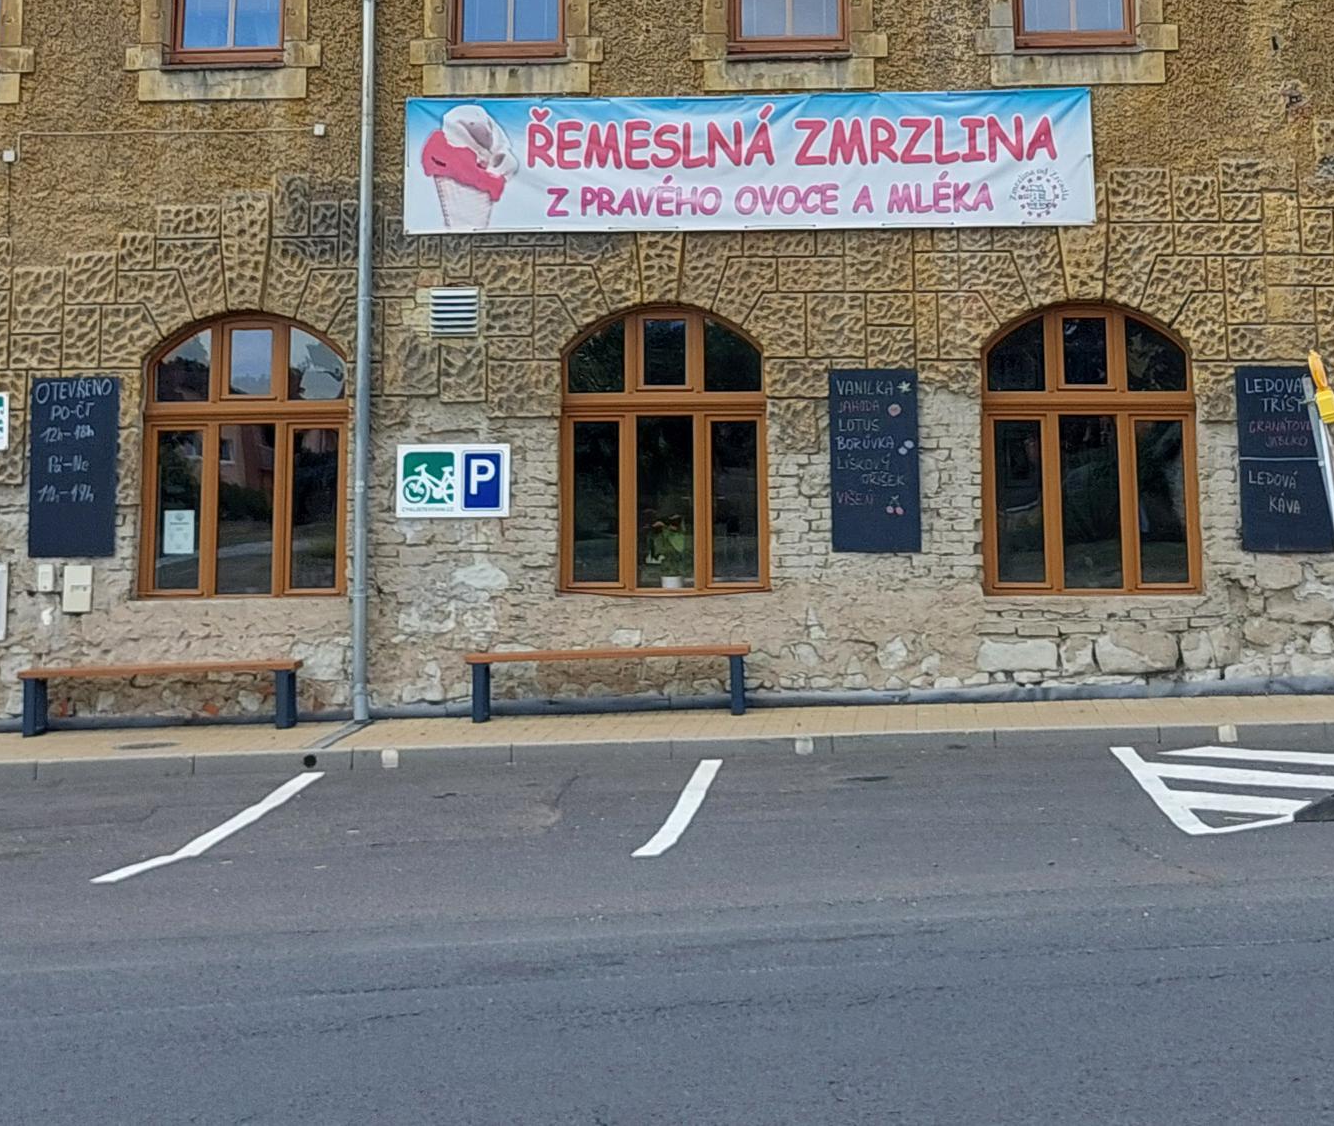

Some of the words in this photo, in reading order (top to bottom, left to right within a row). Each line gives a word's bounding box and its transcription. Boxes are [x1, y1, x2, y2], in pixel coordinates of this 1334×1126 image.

[527, 105, 775, 169] ŘEMESLNÁ
[794, 116, 1058, 166] ZMRZLINA
[546, 187, 570, 217] Z
[580, 175, 722, 217] PRAVÉHO
[734, 183, 839, 216] OVOCE
[852, 184, 874, 214] A
[887, 171, 994, 215] MLÉKA
[35, 377, 113, 405] OTEVŘENO
[836, 379, 894, 396] VANILKA
[837, 399, 880, 413] JAHODA
[838, 418, 881, 432] LOTUS
[469, 458, 496, 495] P
[1248, 470, 1299, 490] LEDOVÁ
[1269, 492, 1302, 514] KÁVA
